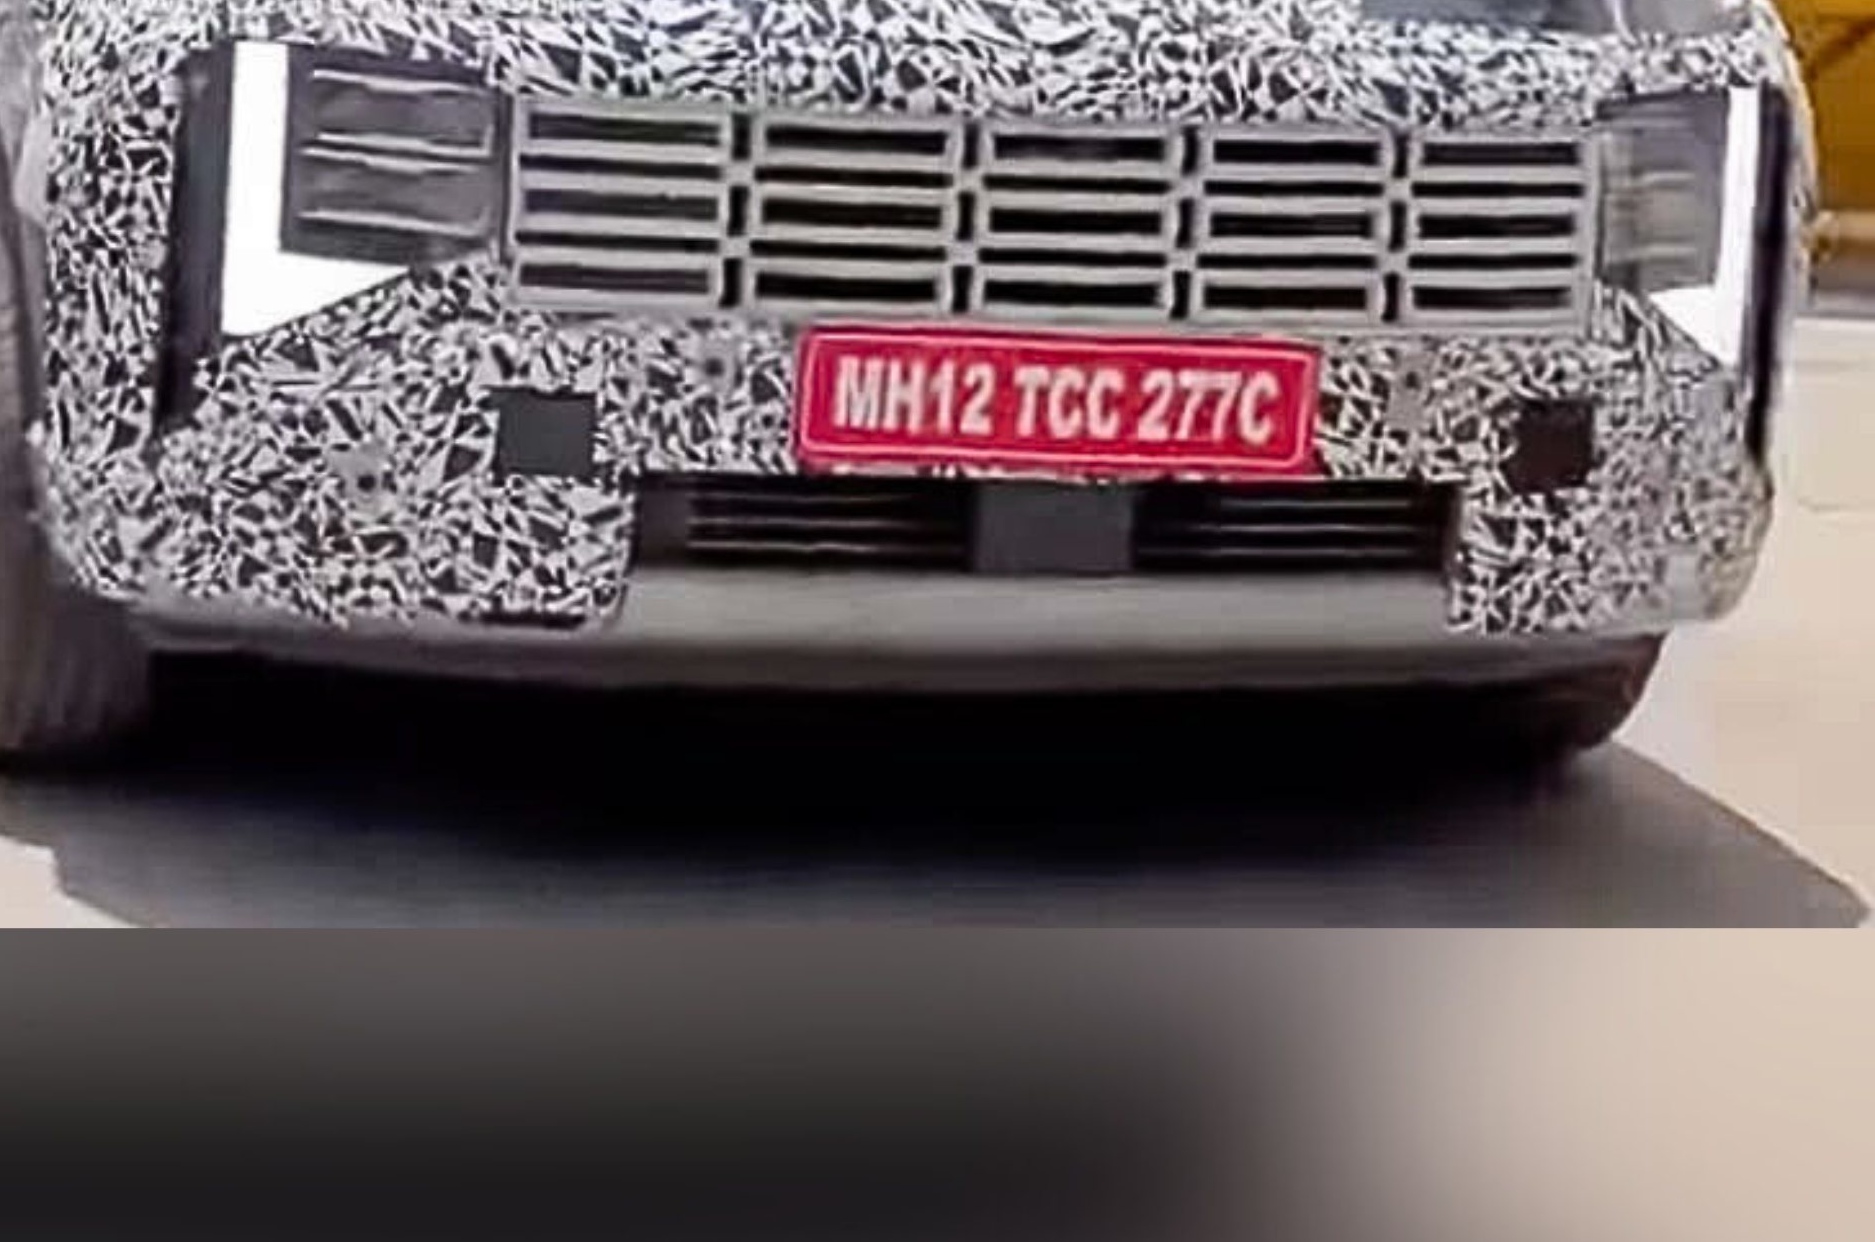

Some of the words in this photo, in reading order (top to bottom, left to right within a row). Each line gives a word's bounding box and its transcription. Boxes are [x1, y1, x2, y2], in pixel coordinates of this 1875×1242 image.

[835, 355, 995, 435] MH12
[1013, 365, 1125, 440] TCC
[1138, 369, 1279, 445] 277C
